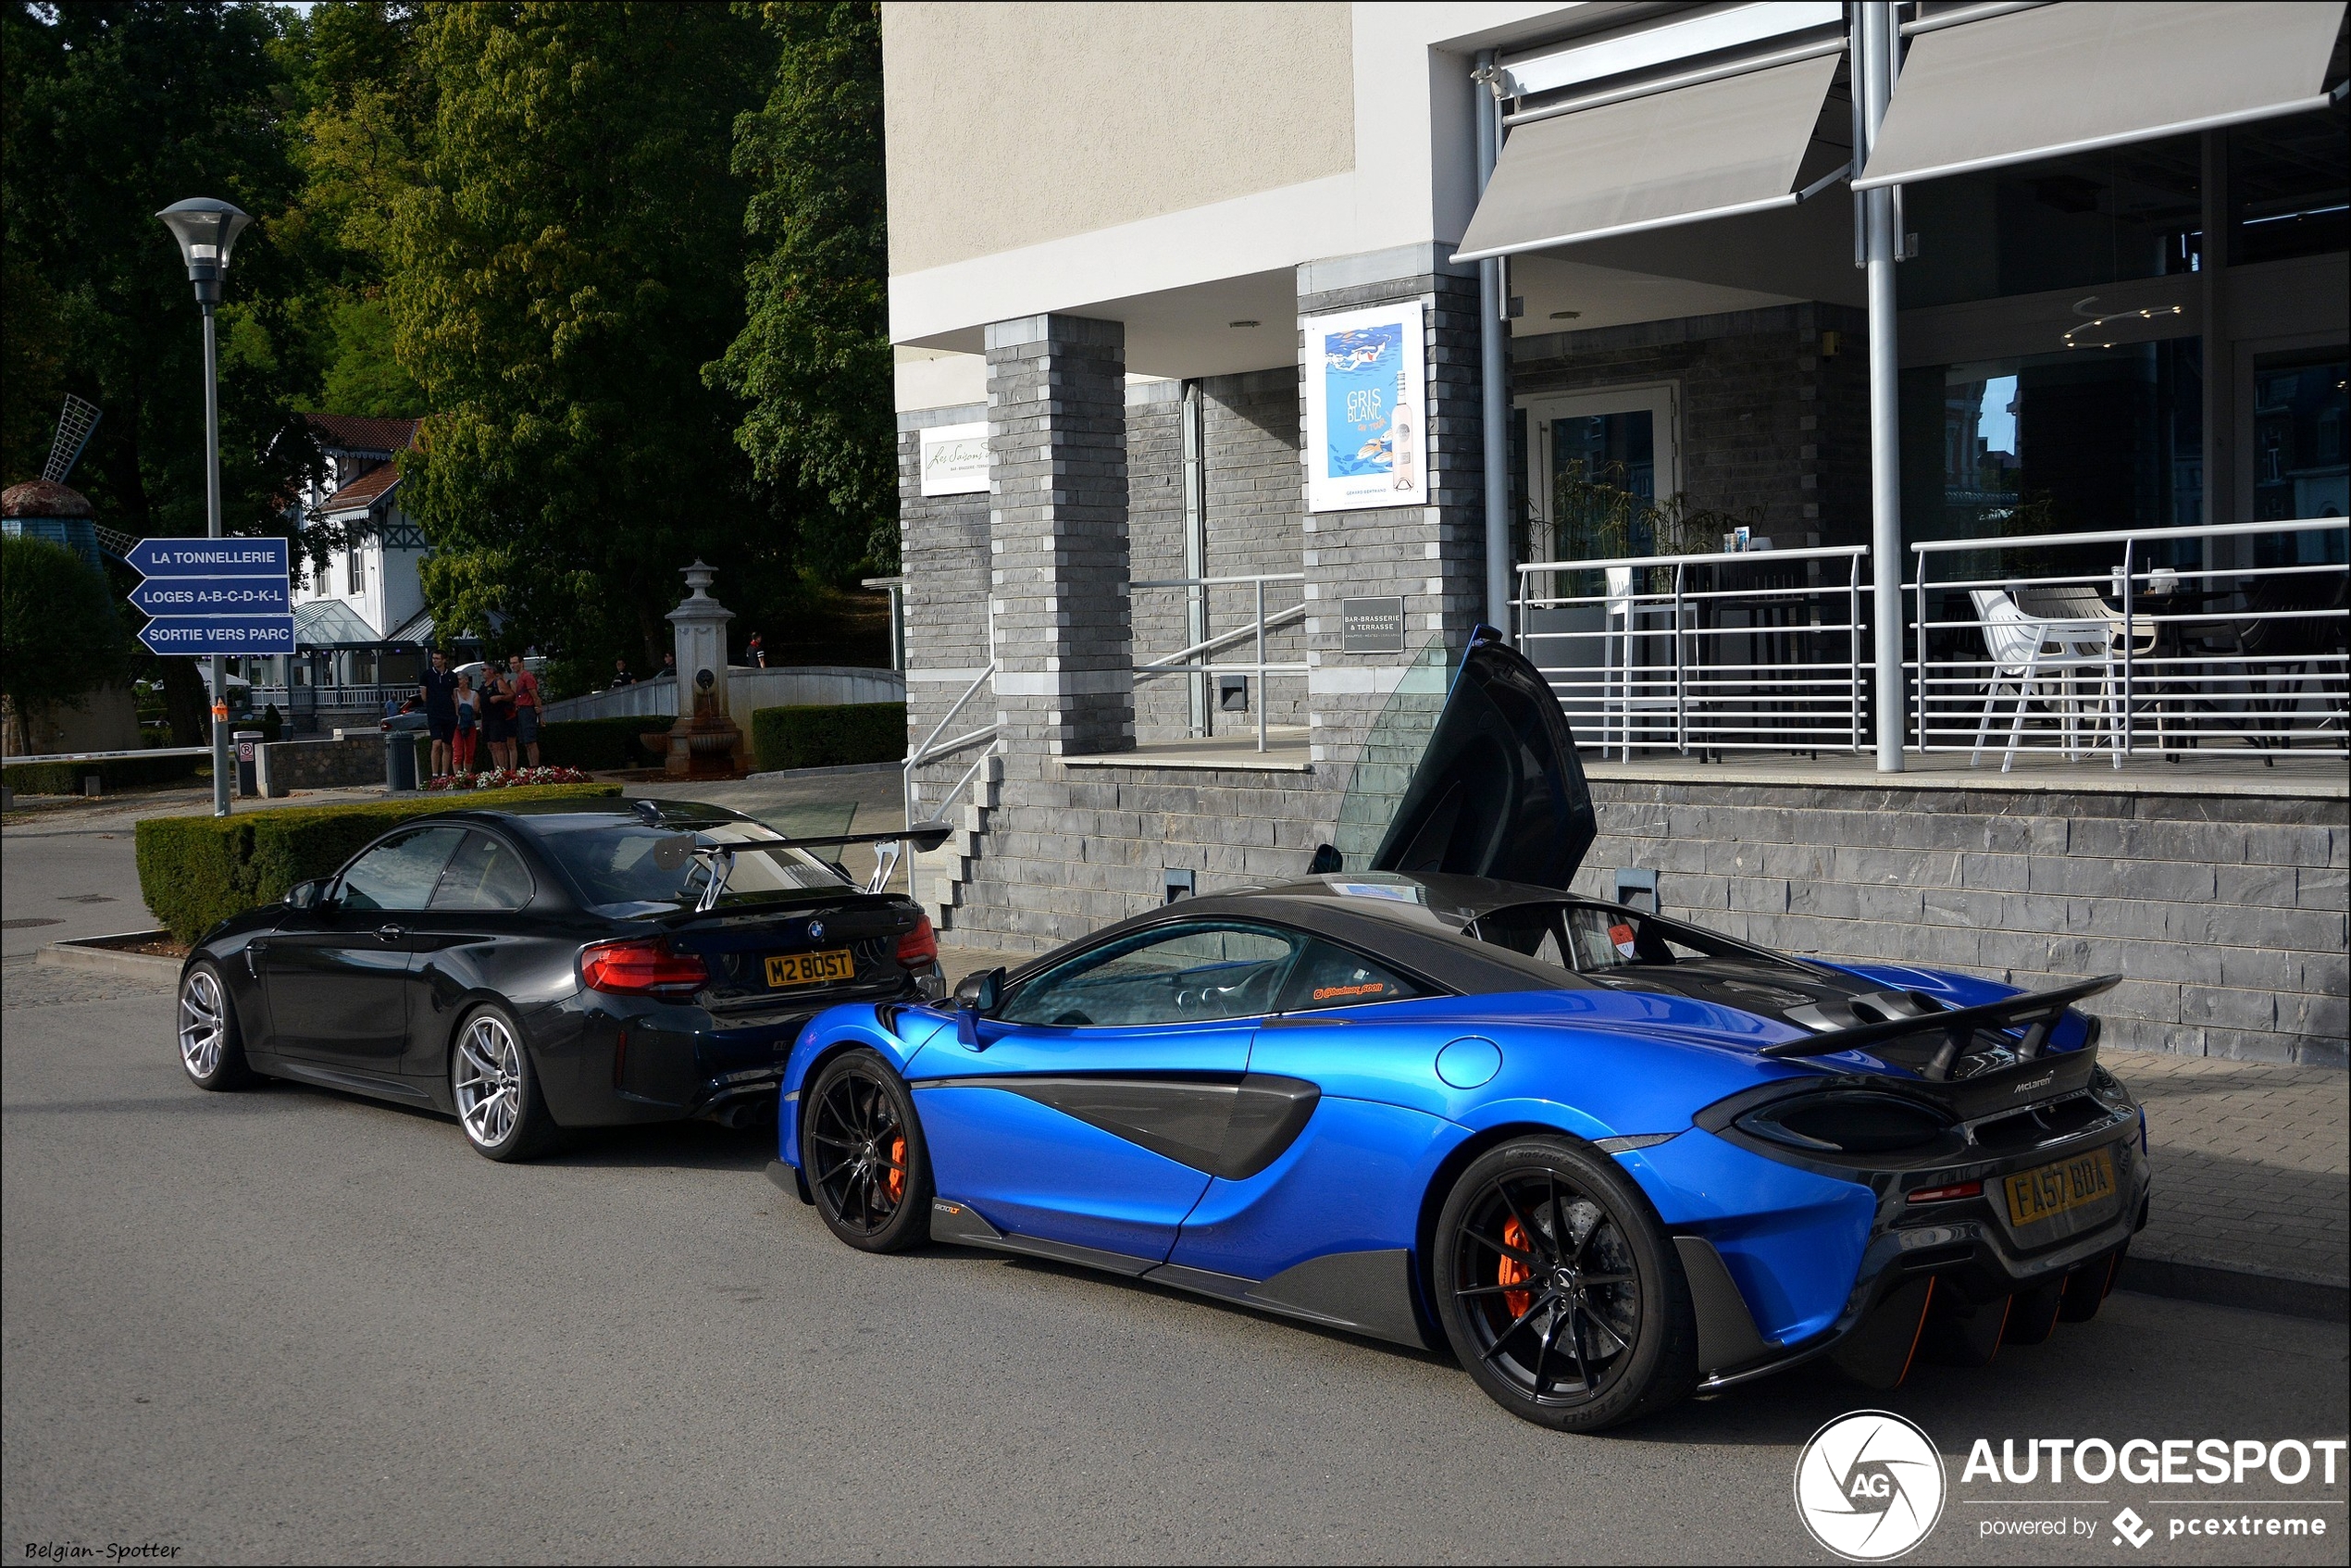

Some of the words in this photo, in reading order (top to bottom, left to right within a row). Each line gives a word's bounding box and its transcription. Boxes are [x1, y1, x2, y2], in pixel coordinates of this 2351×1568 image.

[1347, 388, 1382, 408] GRIS
[1348, 403, 1382, 423] BLANC
[927, 445, 947, 469] Les
[949, 444, 982, 462] Saisons
[152, 553, 170, 564] LA
[174, 552, 276, 563] TONNELLERIE
[144, 591, 193, 603] LOGES
[197, 590, 283, 602] A-B-C-D-K-L
[149, 628, 203, 641] SORTIE
[205, 628, 245, 641] VERS
[249, 628, 290, 641] PARC
[771, 959, 798, 983] M2
[2014, 1076, 2052, 1093] McLaren
[2015, 1167, 2066, 1217] FA57
[2069, 1157, 2108, 1199] BDA
[934, 1203, 960, 1213] 600LT
